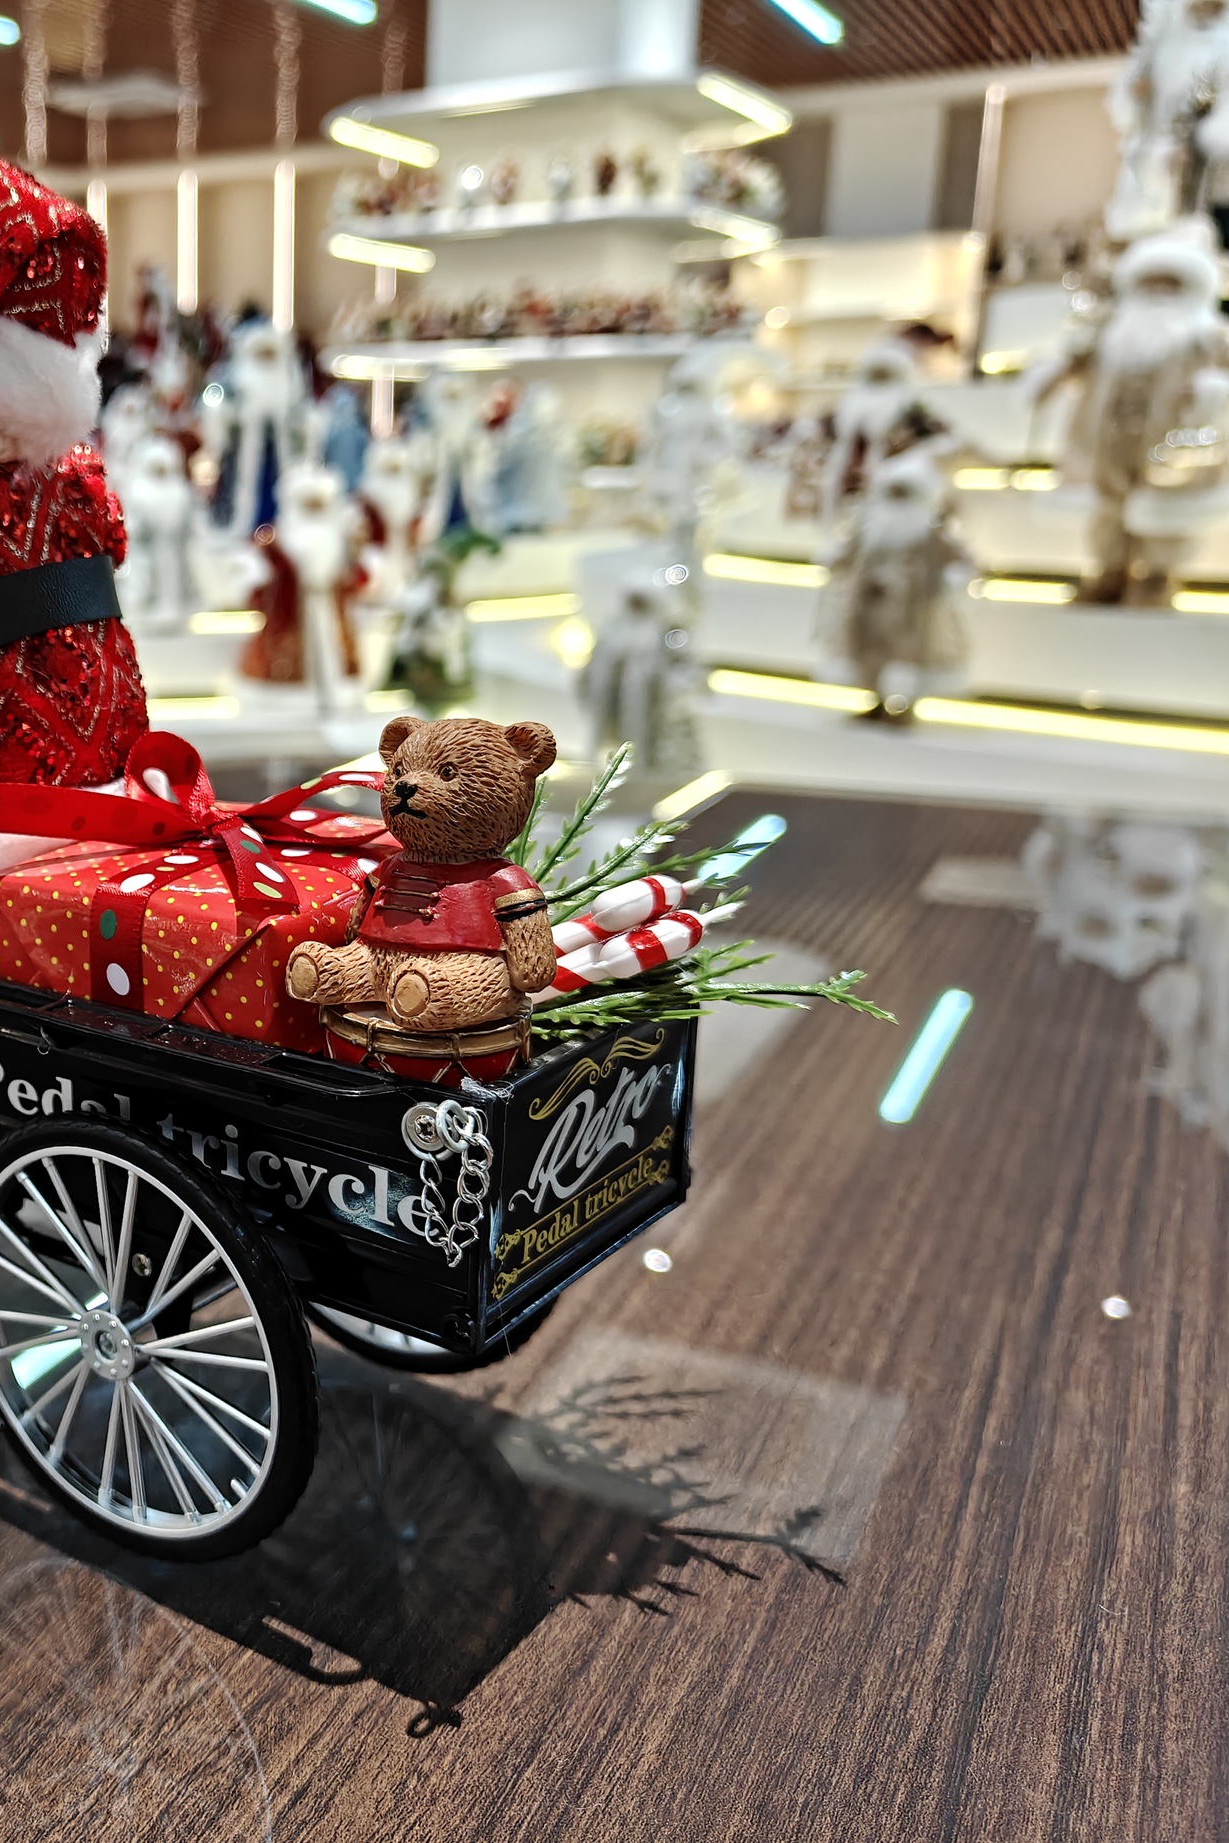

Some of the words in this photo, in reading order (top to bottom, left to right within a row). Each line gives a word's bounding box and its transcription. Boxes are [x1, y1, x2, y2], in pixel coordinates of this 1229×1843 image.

[156, 1113, 440, 1237] tricycle
[508, 1063, 672, 1213] Retro
[521, 1207, 579, 1264] Pedal
[585, 1154, 653, 1217] tricycle
